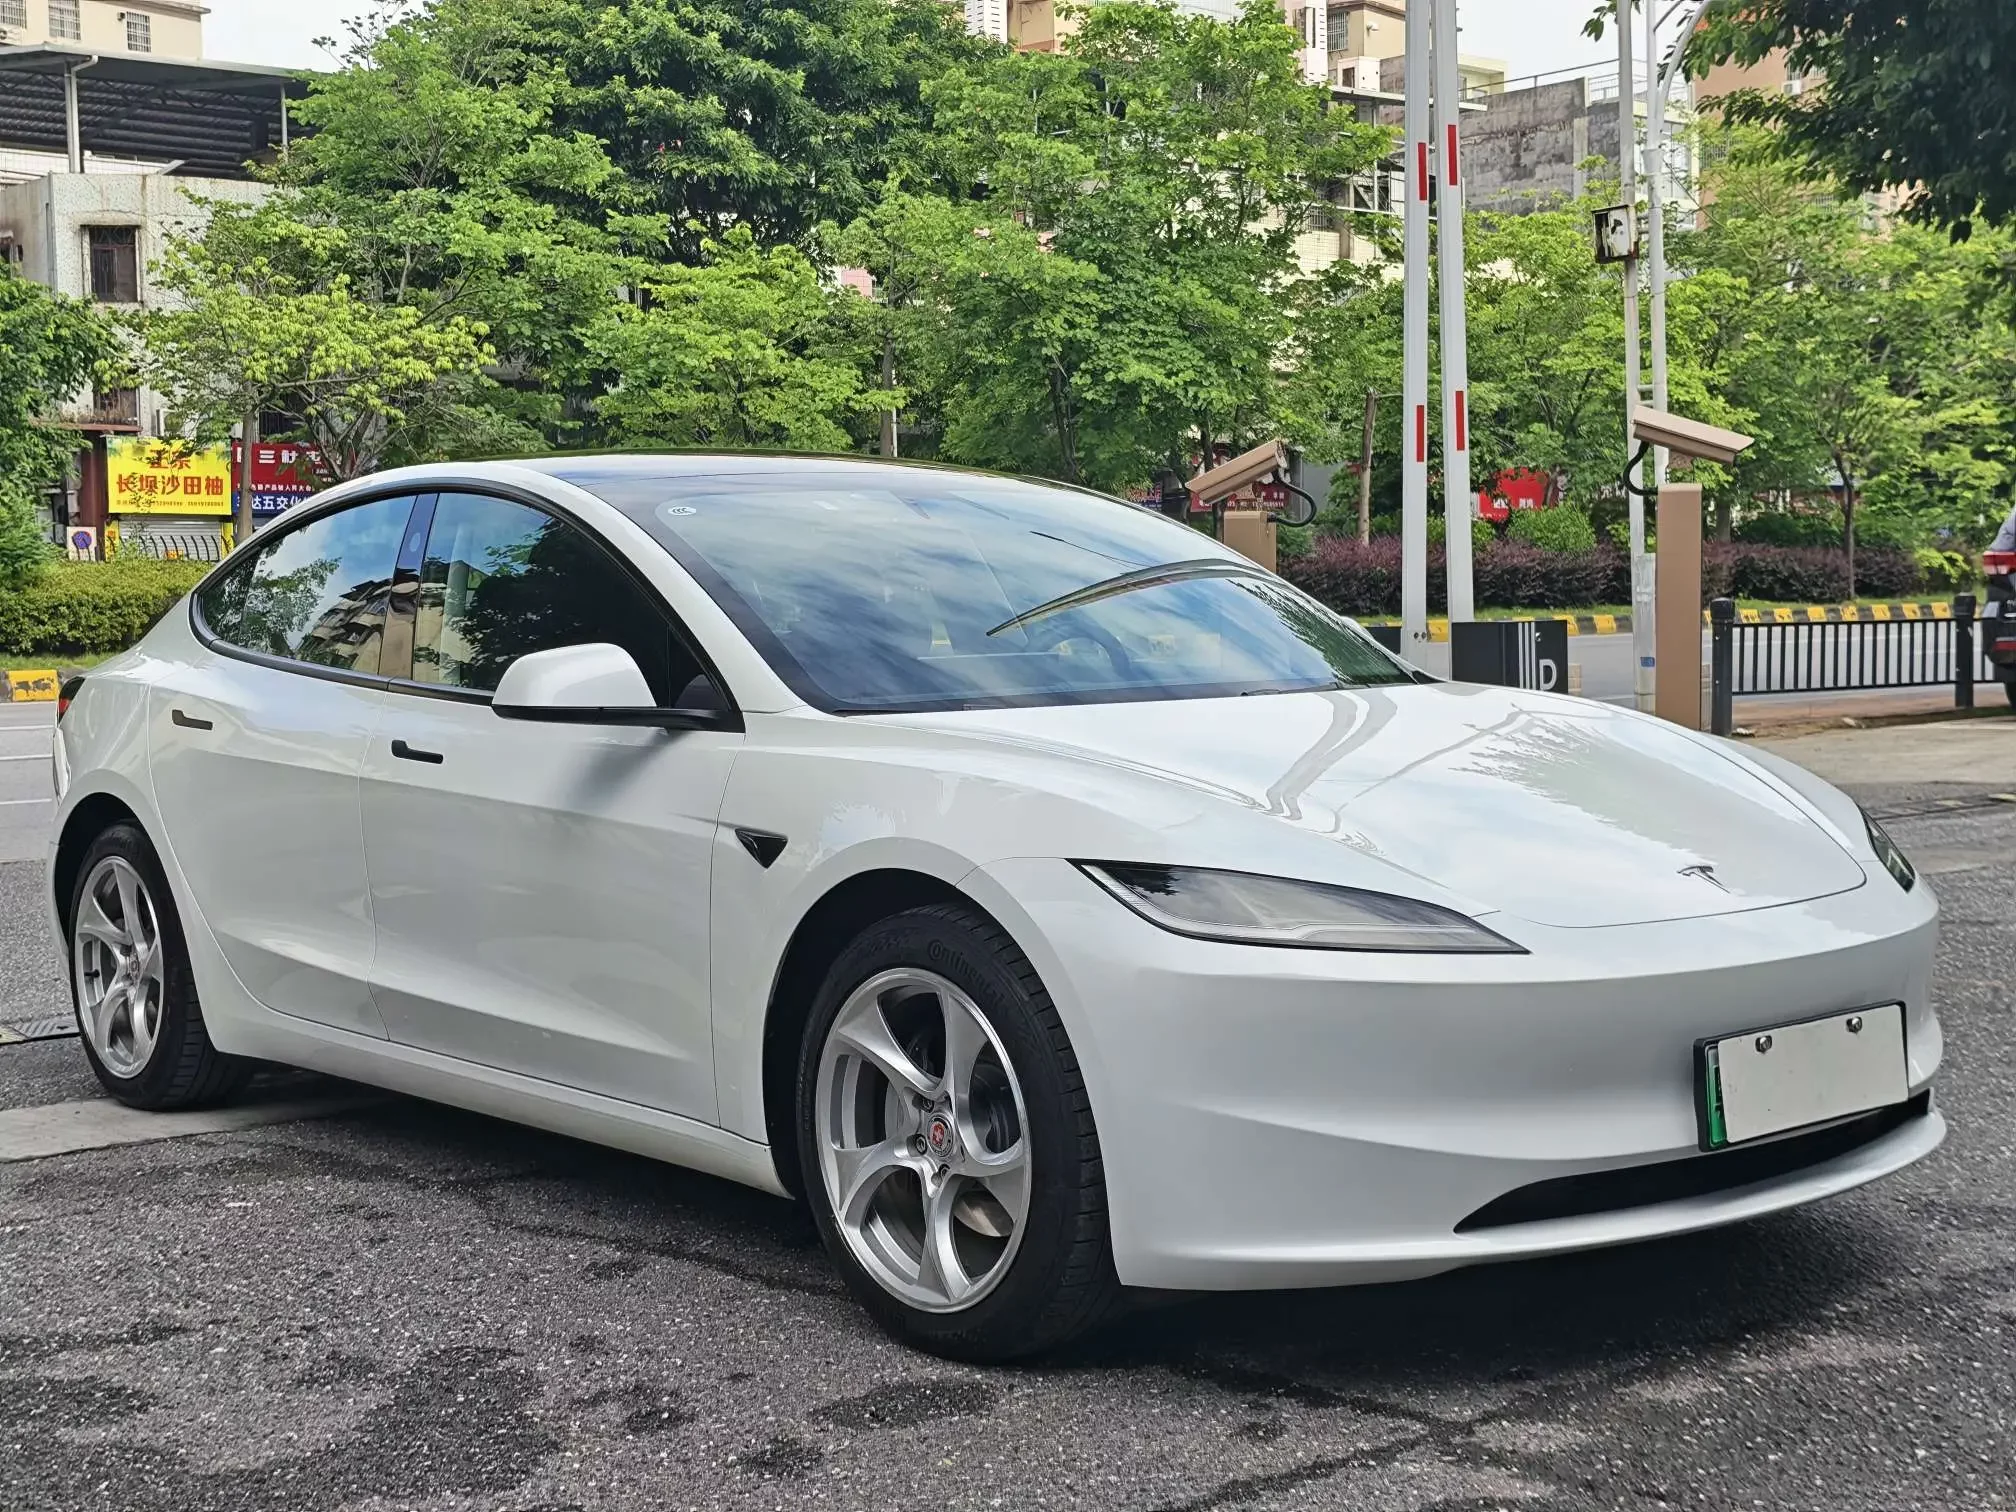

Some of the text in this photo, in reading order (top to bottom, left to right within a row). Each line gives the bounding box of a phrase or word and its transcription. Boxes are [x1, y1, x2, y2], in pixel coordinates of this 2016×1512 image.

[116, 474, 224, 496] 长坝沙田柚
